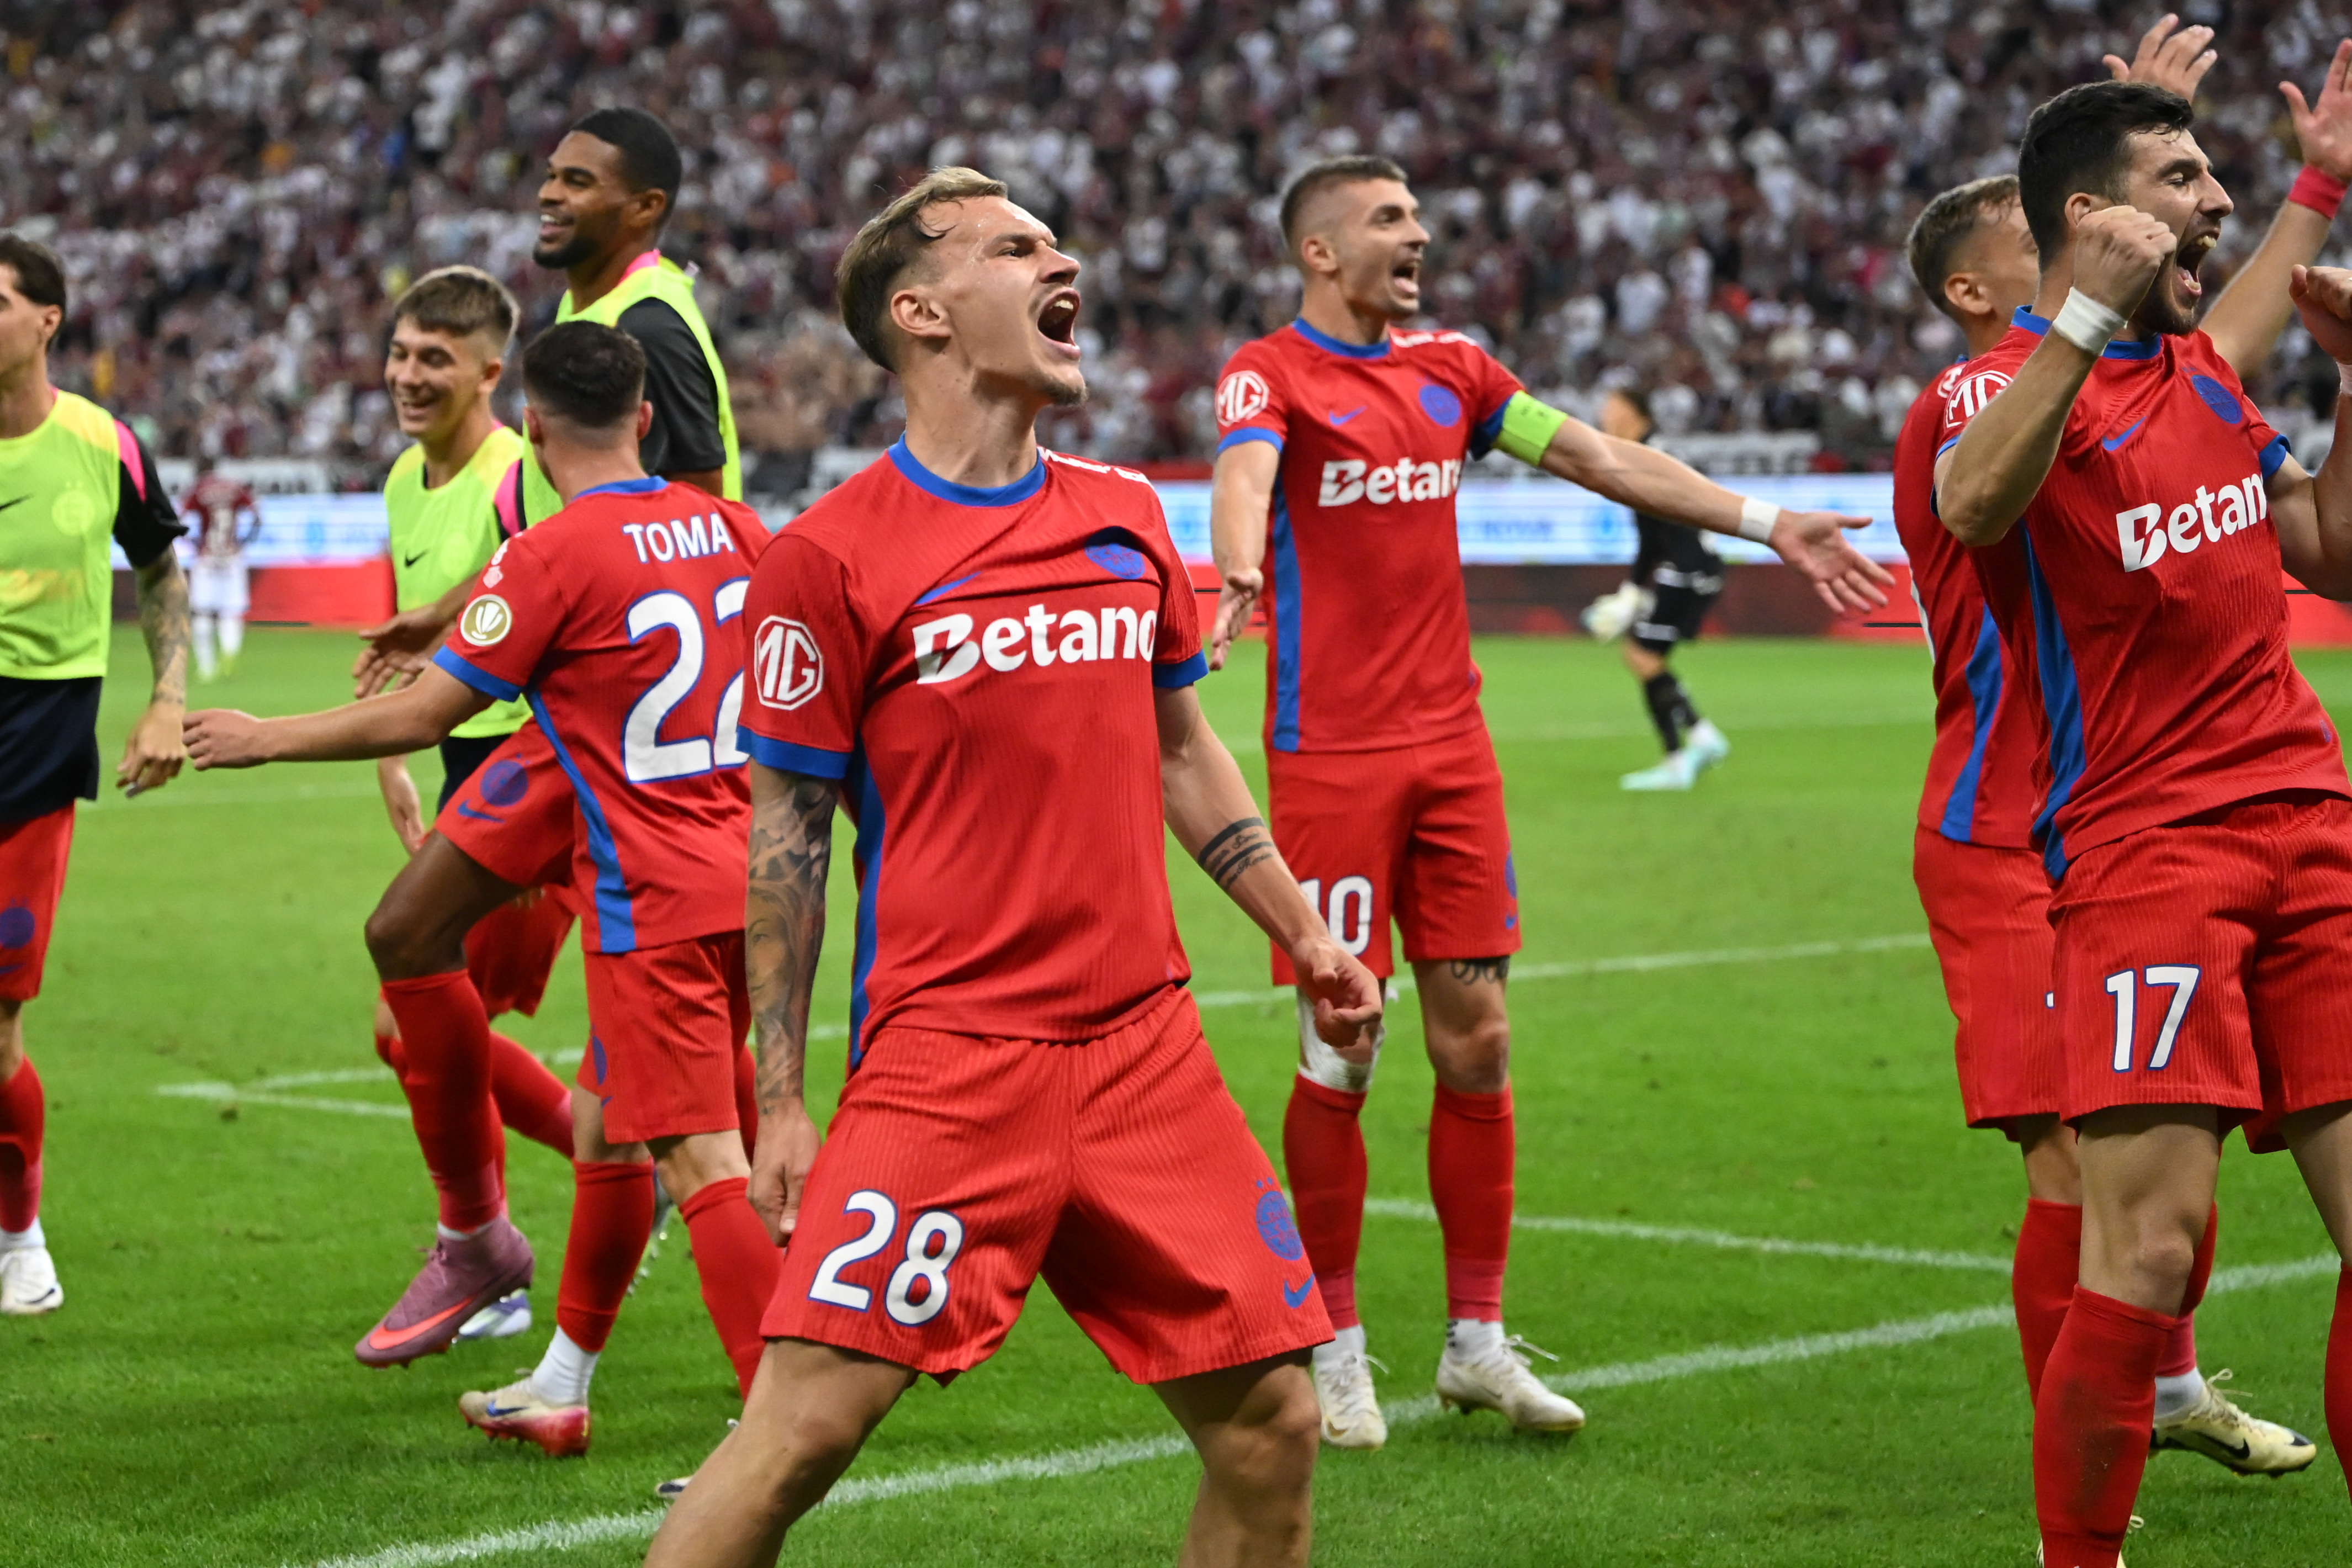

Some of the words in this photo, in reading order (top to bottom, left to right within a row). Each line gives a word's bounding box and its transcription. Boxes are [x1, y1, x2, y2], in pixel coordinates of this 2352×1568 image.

[1219, 376, 1262, 420] MG
[1317, 456, 1463, 507] Betan
[622, 512, 735, 564] TOMA
[2116, 473, 2266, 573] Betan
[757, 626, 818, 702] MG
[912, 603, 1157, 685] Betano
[2105, 963, 2201, 1073] 17
[808, 1189, 965, 1327] 28
